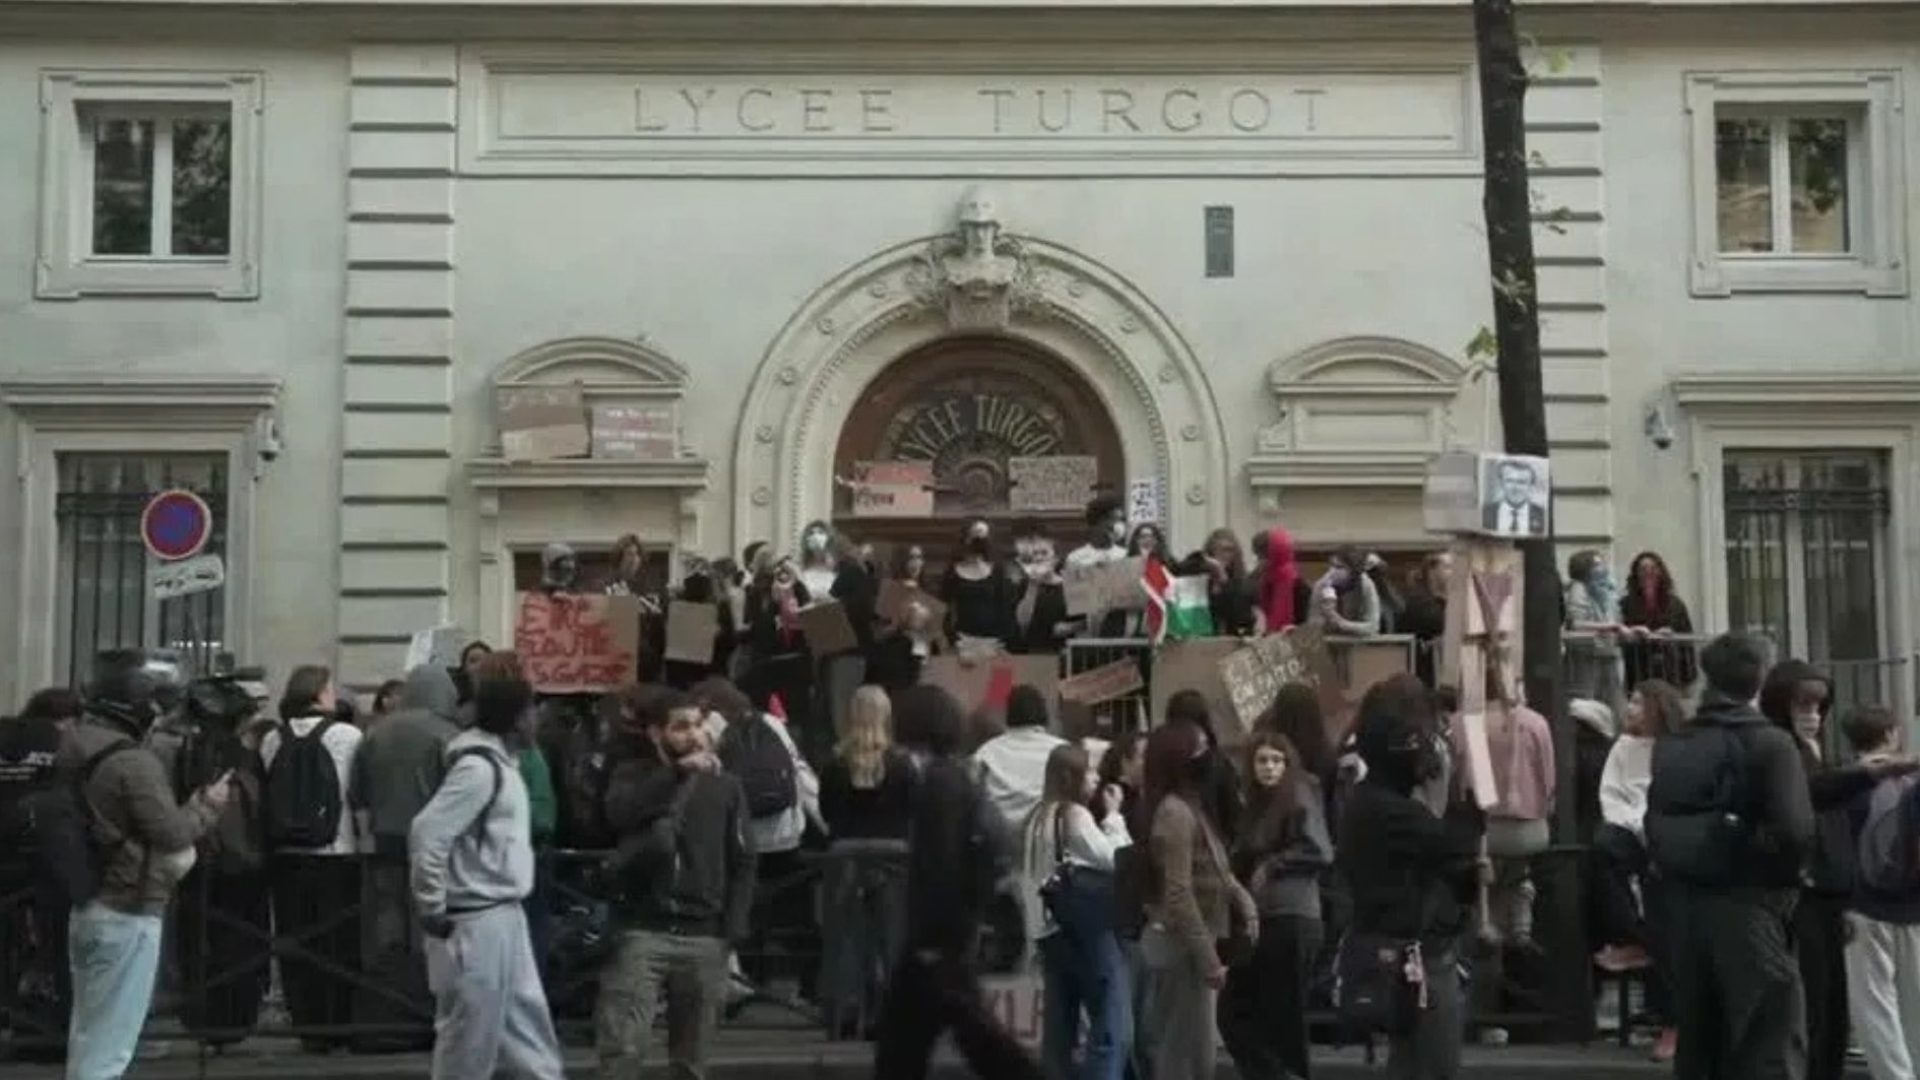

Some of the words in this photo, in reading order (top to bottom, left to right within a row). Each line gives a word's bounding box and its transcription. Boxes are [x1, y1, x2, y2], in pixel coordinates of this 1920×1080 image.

[633, 88, 896, 132] LYCEE
[977, 88, 1328, 132] TURGOT
[894, 398, 967, 460] YCEE
[973, 394, 1057, 457] TURGO
